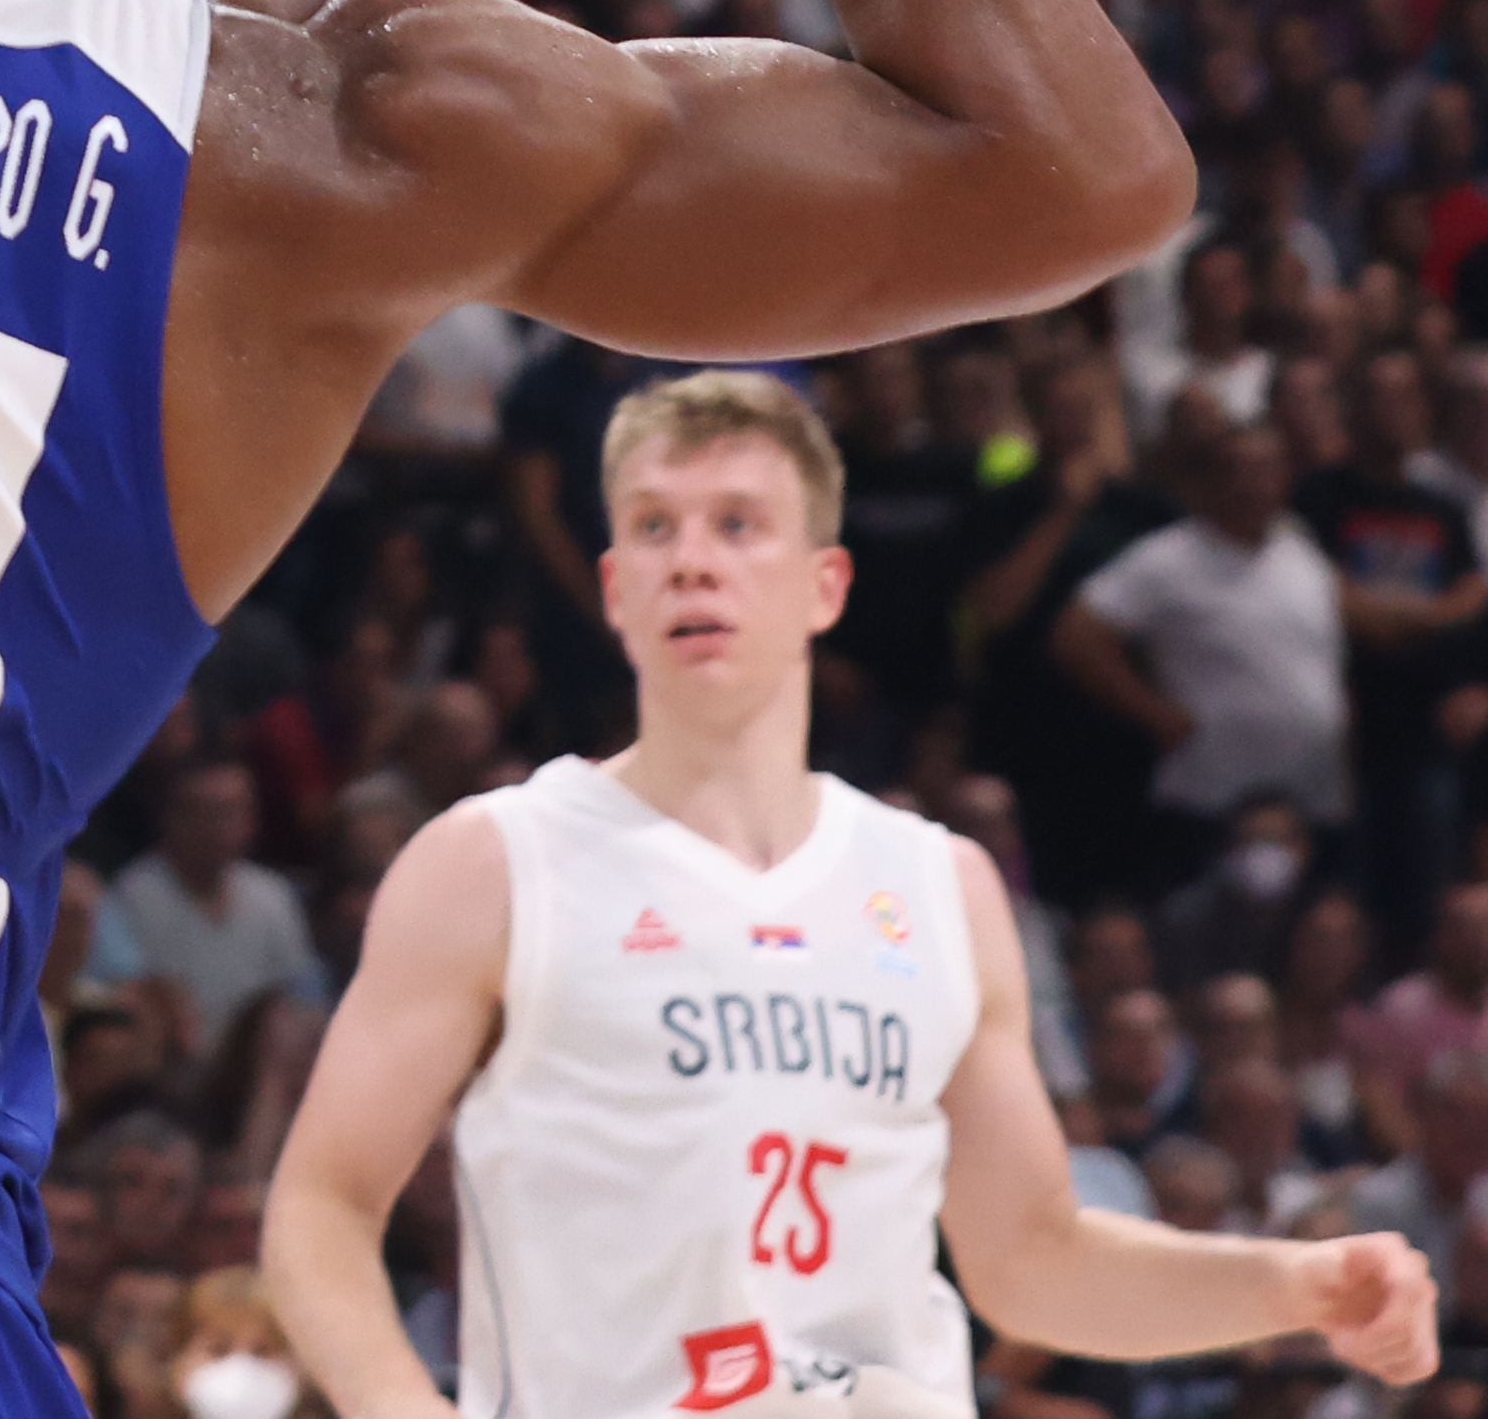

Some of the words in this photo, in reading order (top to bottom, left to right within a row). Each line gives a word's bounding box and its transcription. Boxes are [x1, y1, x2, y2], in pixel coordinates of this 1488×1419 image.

[63, 114, 129, 271] G.
[661, 993, 909, 1101] SRBIJA
[747, 1130, 849, 1277] 25
